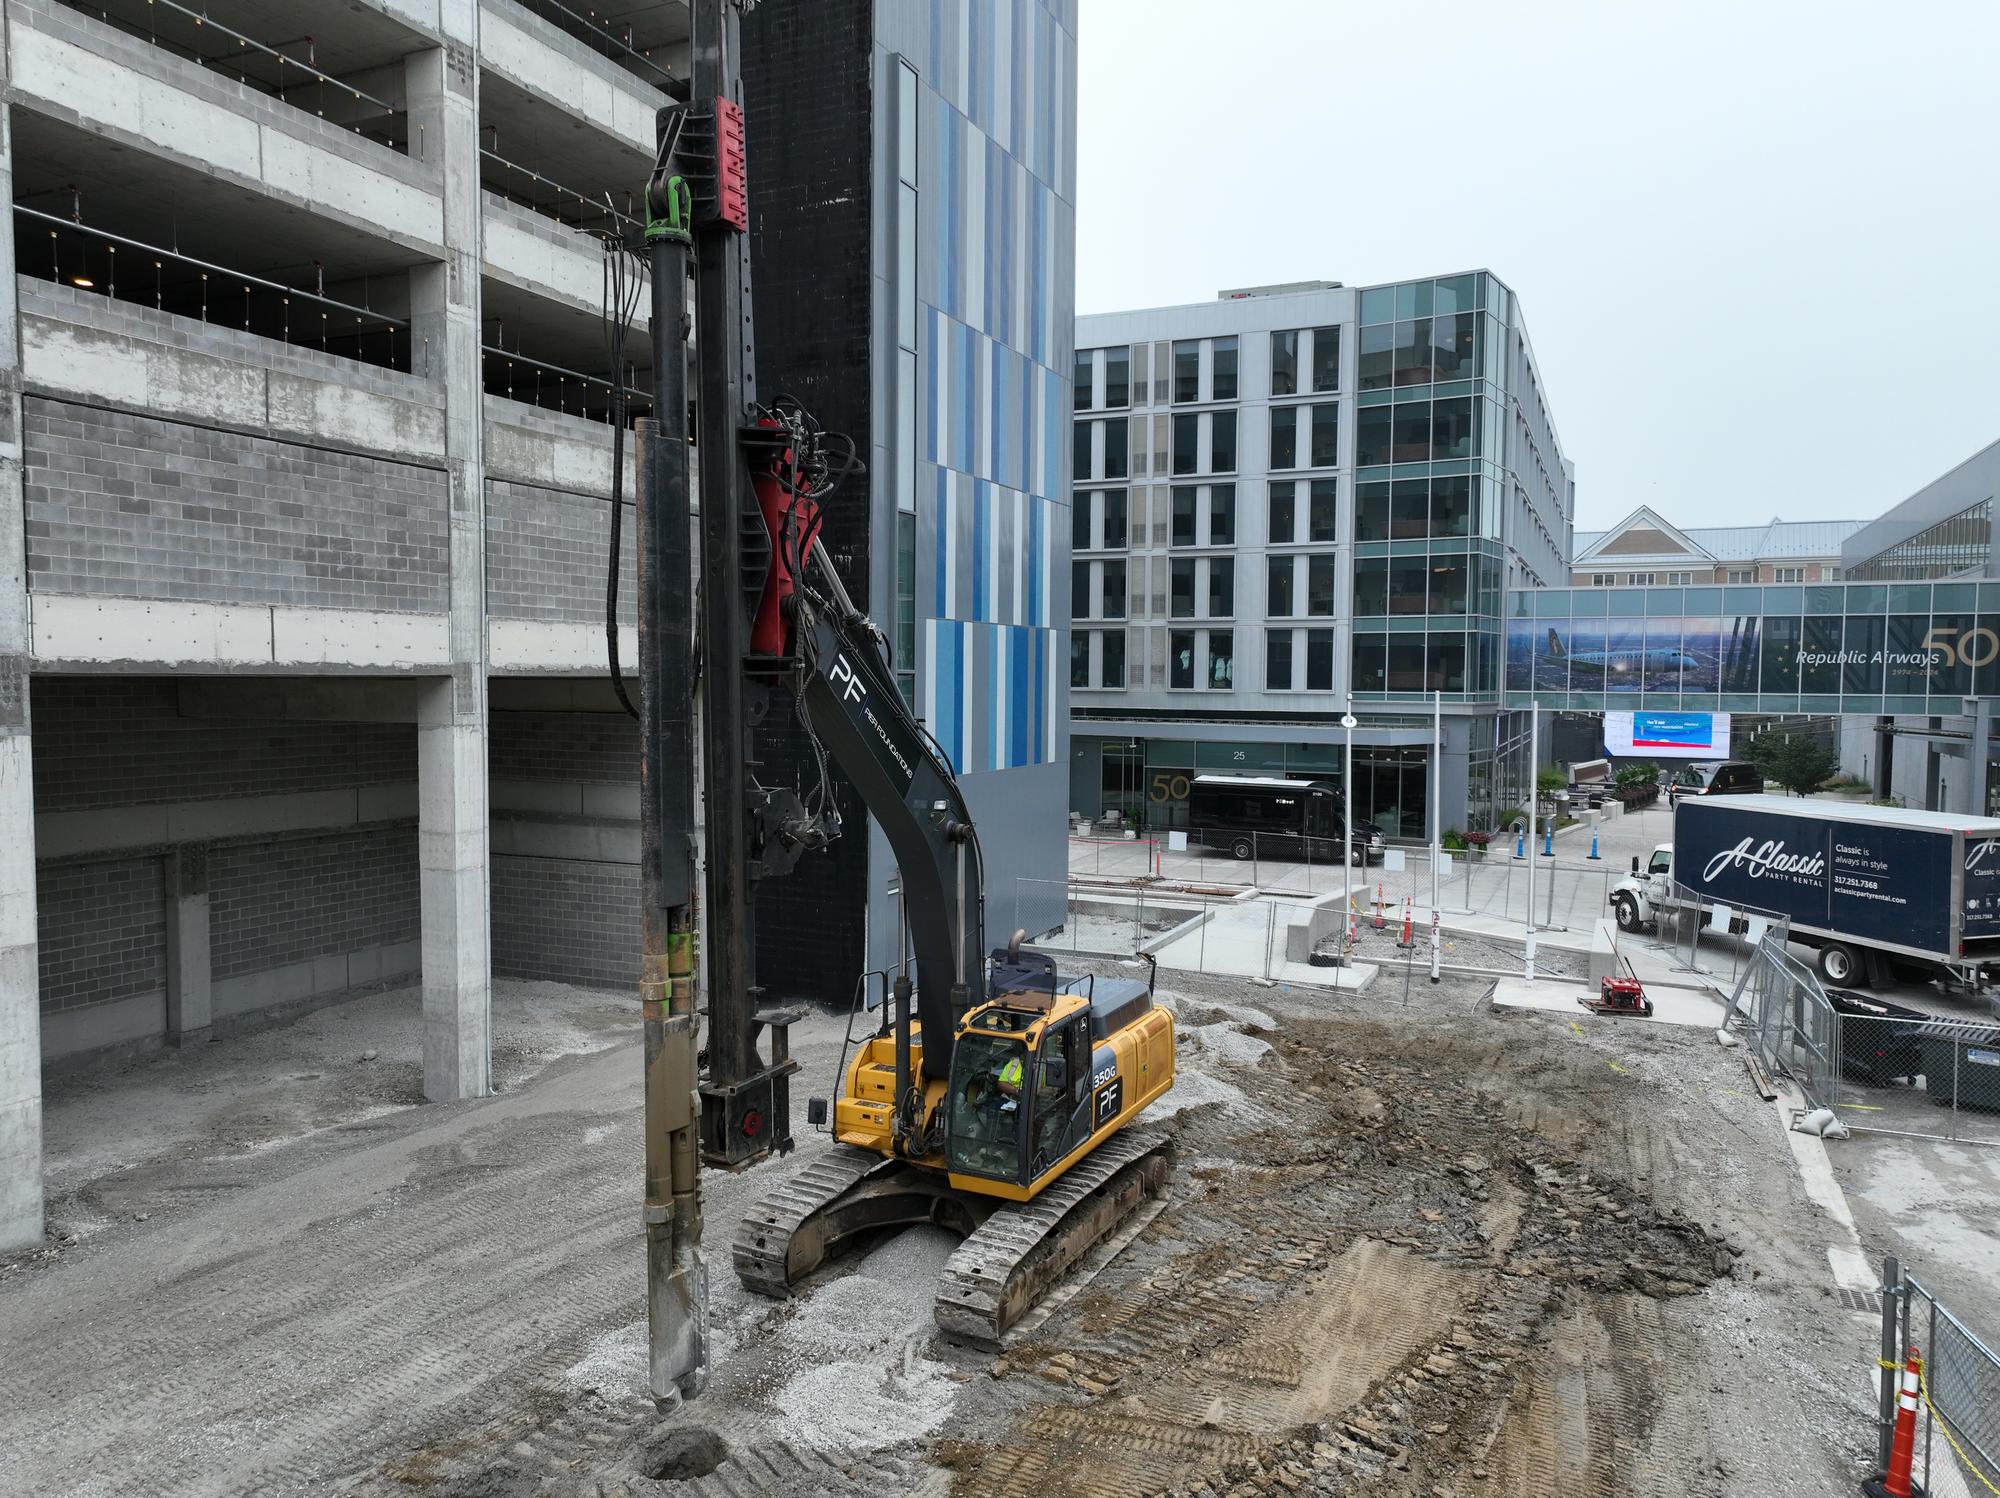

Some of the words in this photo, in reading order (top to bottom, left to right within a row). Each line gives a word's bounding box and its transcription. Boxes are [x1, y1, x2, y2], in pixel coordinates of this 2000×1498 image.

[1920, 627, 2000, 667] 50
[1795, 650, 1867, 667] Republic
[1870, 650, 1940, 668] Airways
[876, 724, 914, 779] FOUNDATIONS
[1233, 751, 1246, 760] 25
[1150, 775, 1191, 804] 50
[1835, 844, 1862, 855] Classic
[1863, 848, 1870, 856] is
[1703, 836, 1754, 882] A
[1748, 840, 1825, 878] Classic
[1835, 855, 1860, 867] always
[1861, 859, 1868, 867] in
[1870, 861, 1888, 871] style
[1765, 871, 1790, 881] PARTY
[1793, 876, 1823, 888] RENTAL
[1834, 875, 1878, 889] 317.251.7368
[1834, 887, 1907, 904] aclassicpartyrental.com
[1094, 1065, 1116, 1089] 350G
